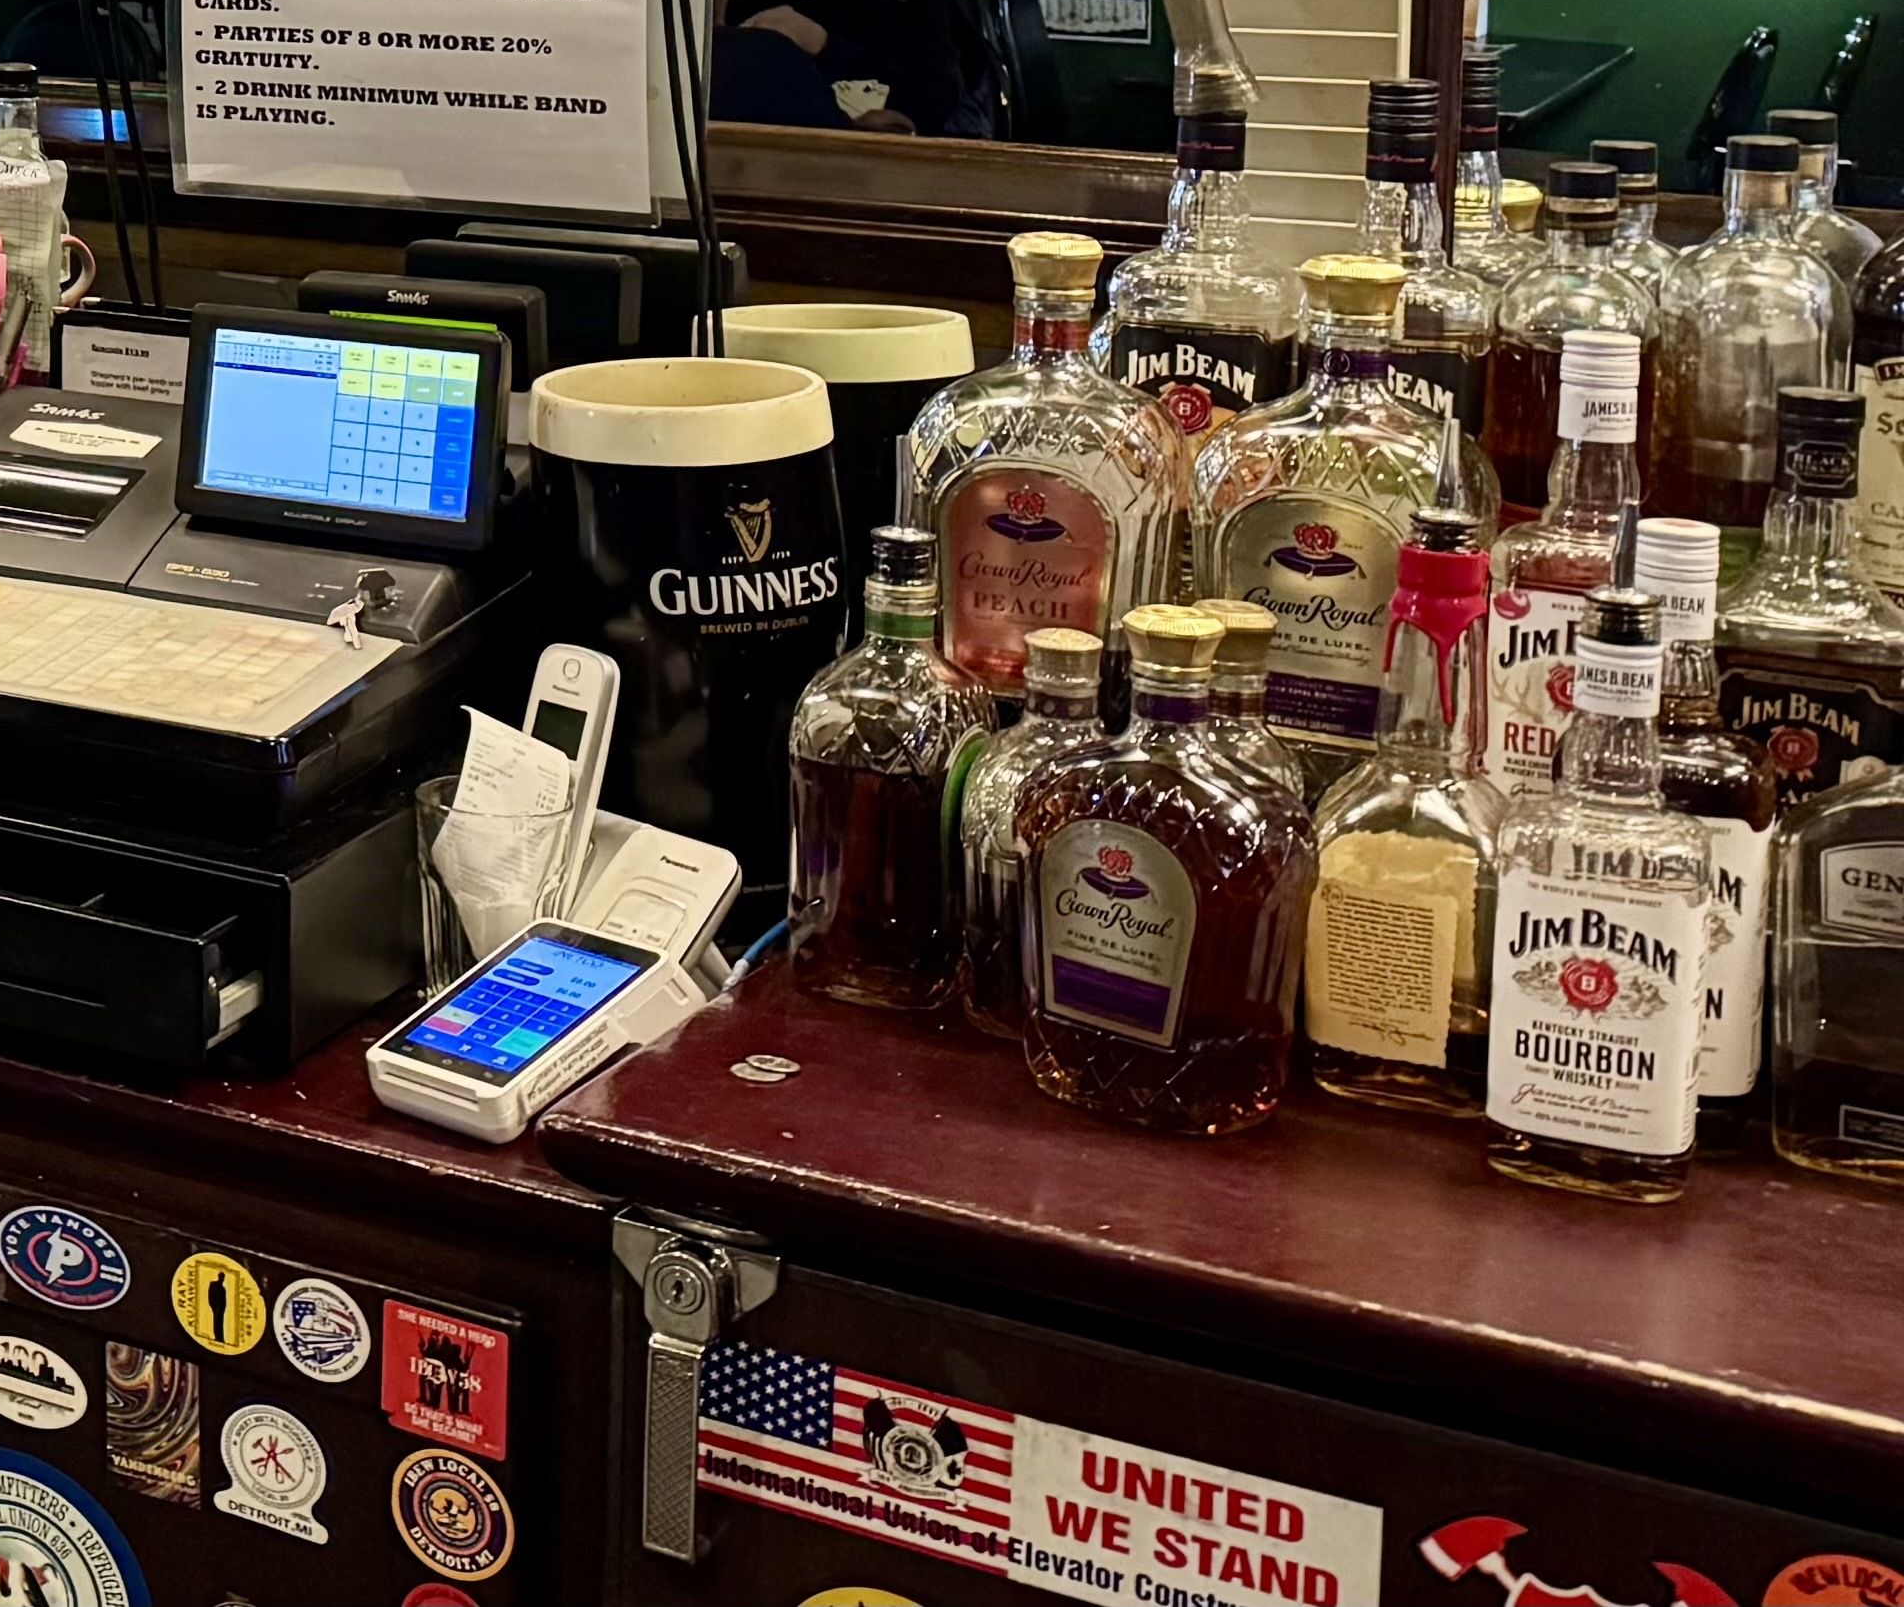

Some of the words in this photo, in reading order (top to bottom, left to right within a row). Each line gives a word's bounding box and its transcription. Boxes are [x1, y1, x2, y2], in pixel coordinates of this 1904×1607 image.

[196, 50, 320, 70] GRATUITY.
[214, 25, 313, 43] PARTIES
[320, 29, 352, 45] OF
[358, 31, 371, 46] 8
[378, 32, 413, 48] OR
[419, 34, 495, 51] MORE
[501, 38, 552, 54] 20%
[196, 104, 218, 119] IS
[223, 105, 335, 126] PLAYING.
[215, 81, 227, 95] 2
[233, 81, 312, 99] DRINK
[317, 85, 439, 105] MINIMUM
[443, 91, 528, 110] WHILE
[535, 96, 607, 114] BAND
[650, 557, 838, 615] GUINNESS
[973, 590, 1069, 620] PEACH
[1056, 889, 1110, 929] Crown
[1111, 902, 1174, 938] Royal
[1509, 911, 1574, 957] JIM
[1581, 909, 1678, 985] BEAM
[1532, 1020, 1584, 1039] KENTUCKY
[1589, 1029, 1639, 1046] STRAIGHT
[1515, 1030, 1655, 1080] BOURBON
[1081, 1449, 1304, 1544] UNITED
[1046, 1496, 1132, 1554] WE
[1154, 1523, 1340, 1606] STAND
